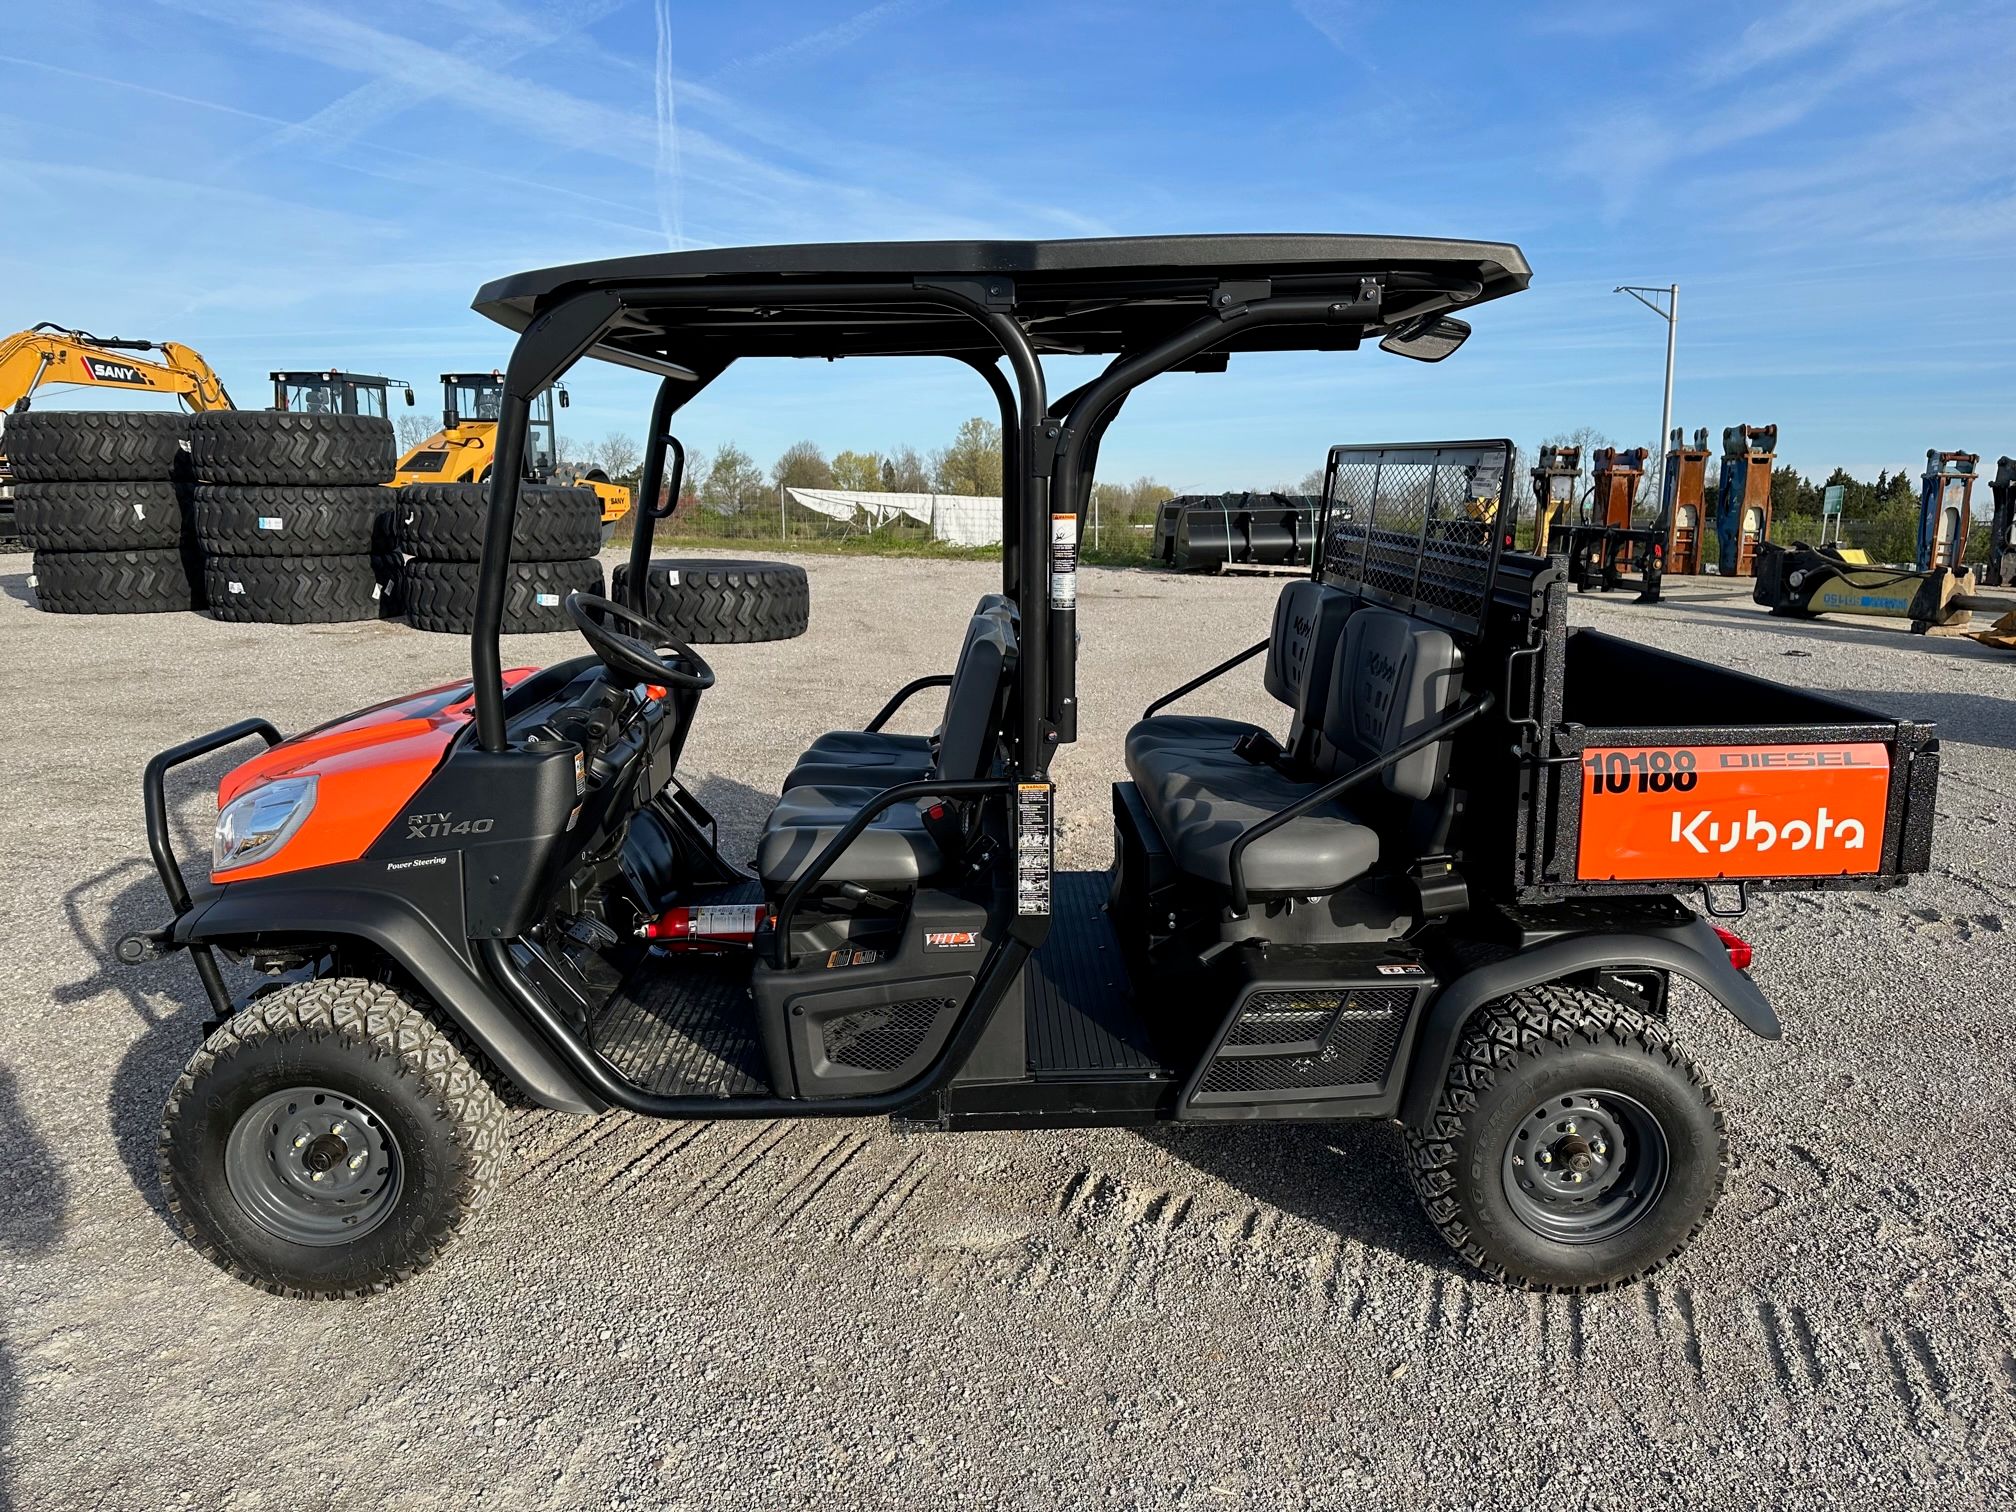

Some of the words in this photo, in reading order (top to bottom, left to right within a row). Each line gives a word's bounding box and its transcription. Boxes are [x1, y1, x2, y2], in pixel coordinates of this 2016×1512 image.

[94, 364, 134, 380] SANY
[610, 497, 625, 505] SANY
[1720, 752, 1871, 768] DIESEL
[1585, 750, 1697, 795] 10188
[408, 812, 453, 825] RTV
[406, 819, 494, 840] X1140
[1670, 807, 1865, 854] Kubota
[387, 862, 412, 871] Power
[413, 856, 447, 868] Steering
